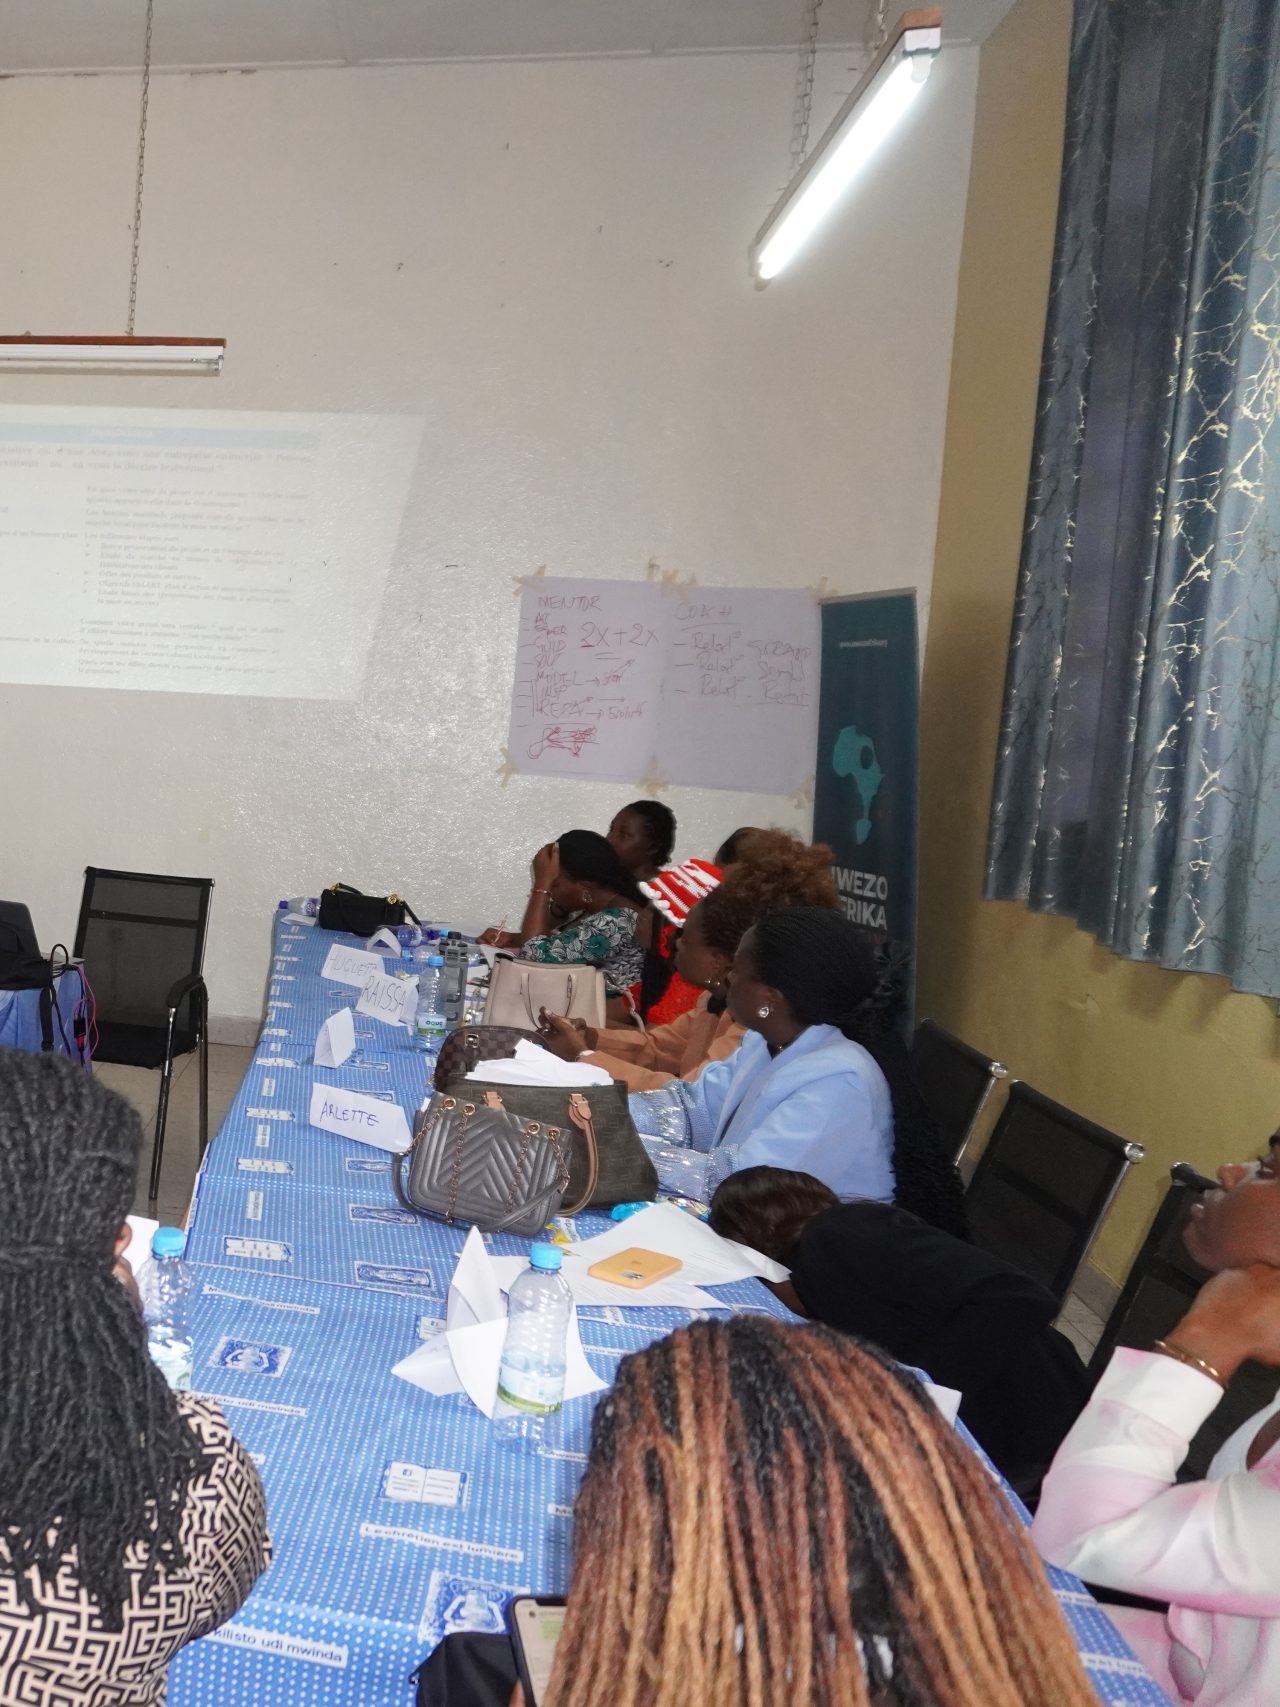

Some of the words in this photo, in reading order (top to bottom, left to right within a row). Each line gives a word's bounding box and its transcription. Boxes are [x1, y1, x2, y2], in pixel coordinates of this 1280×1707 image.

[320, 1100, 380, 1127] ARLETTE
[213, 1628, 257, 1644] kilisto
[261, 1637, 284, 1650] udi
[286, 1643, 343, 1663] mwinda
